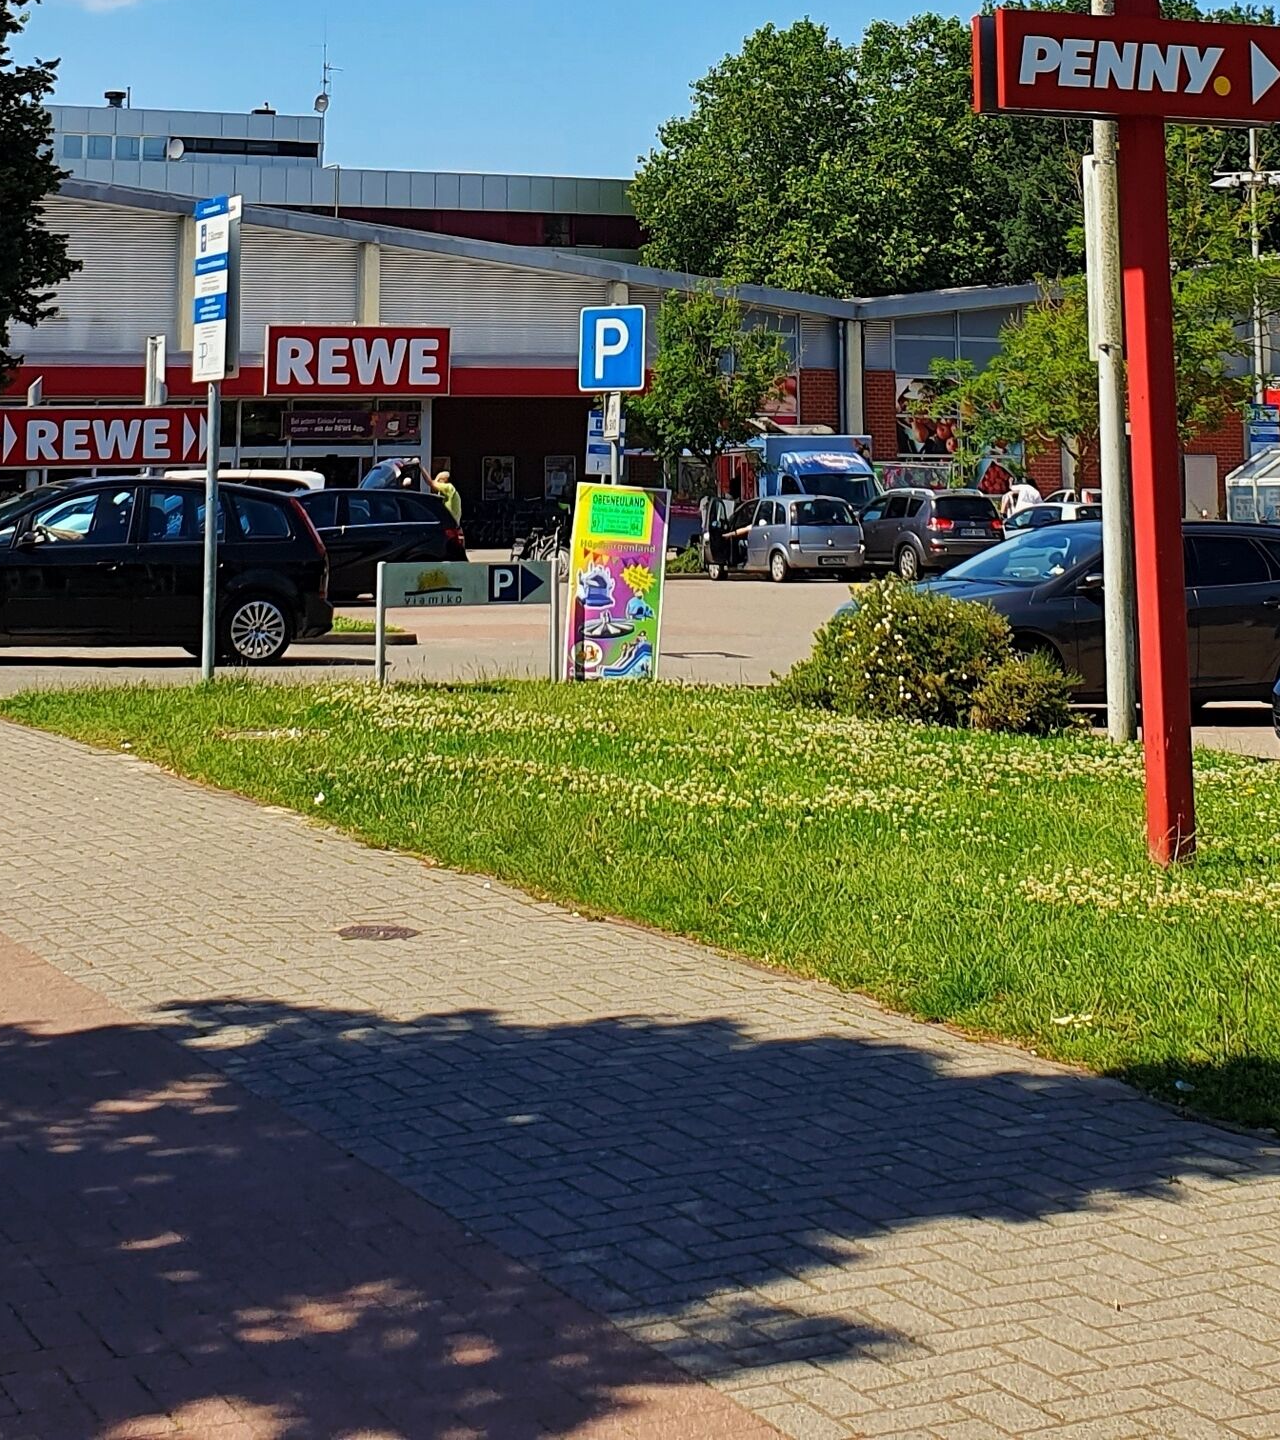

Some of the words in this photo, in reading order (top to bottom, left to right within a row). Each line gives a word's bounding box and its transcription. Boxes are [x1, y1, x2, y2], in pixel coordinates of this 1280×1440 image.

[275, 337, 440, 386] REWE
[595, 318, 629, 379] P
[25, 419, 171, 461] REWE
[404, 594, 462, 605] viamiko
[494, 569, 514, 598] P
